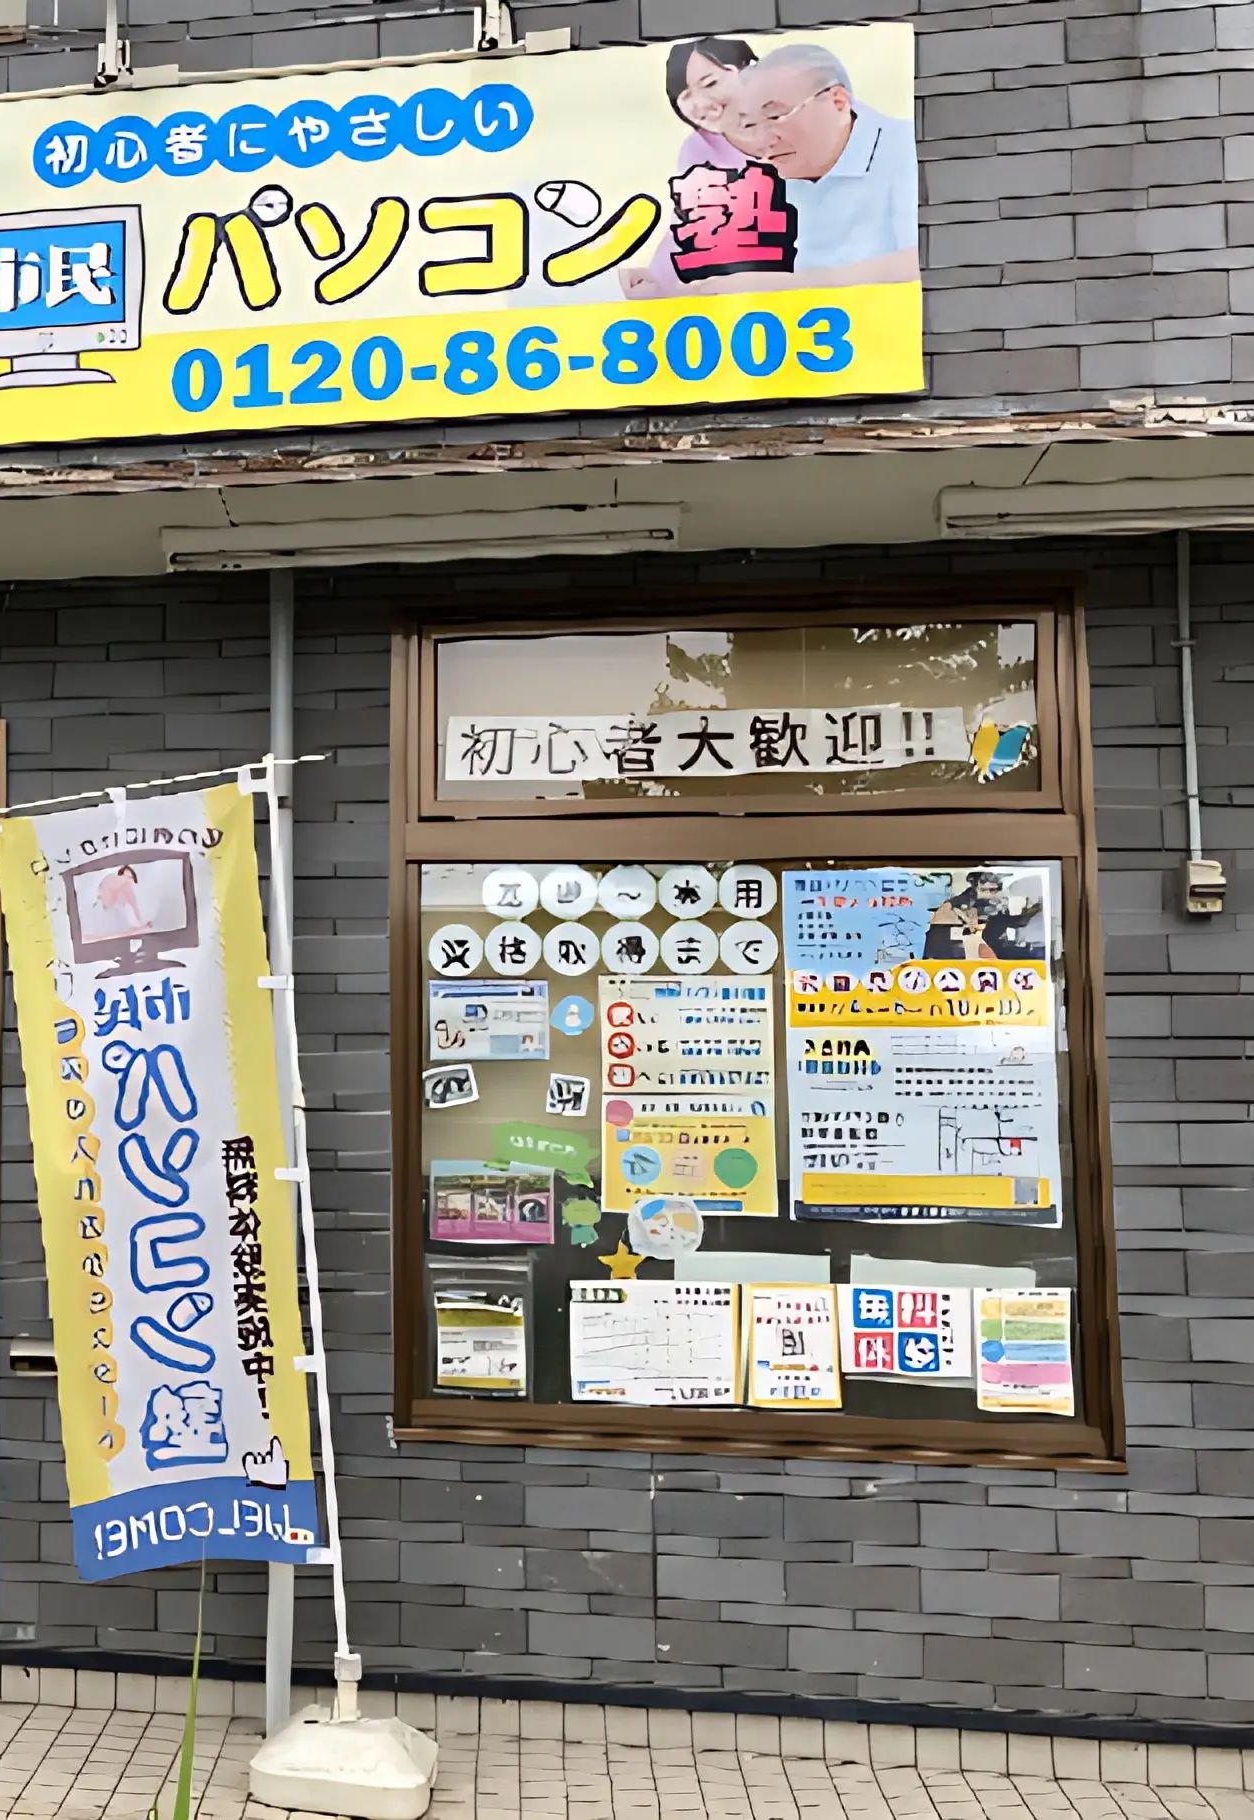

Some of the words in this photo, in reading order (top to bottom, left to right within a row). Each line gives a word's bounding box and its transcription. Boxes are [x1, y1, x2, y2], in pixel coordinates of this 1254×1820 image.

[43, 98, 521, 173] 初心者にやさしい
[171, 306, 854, 414] 0120-86-8003
